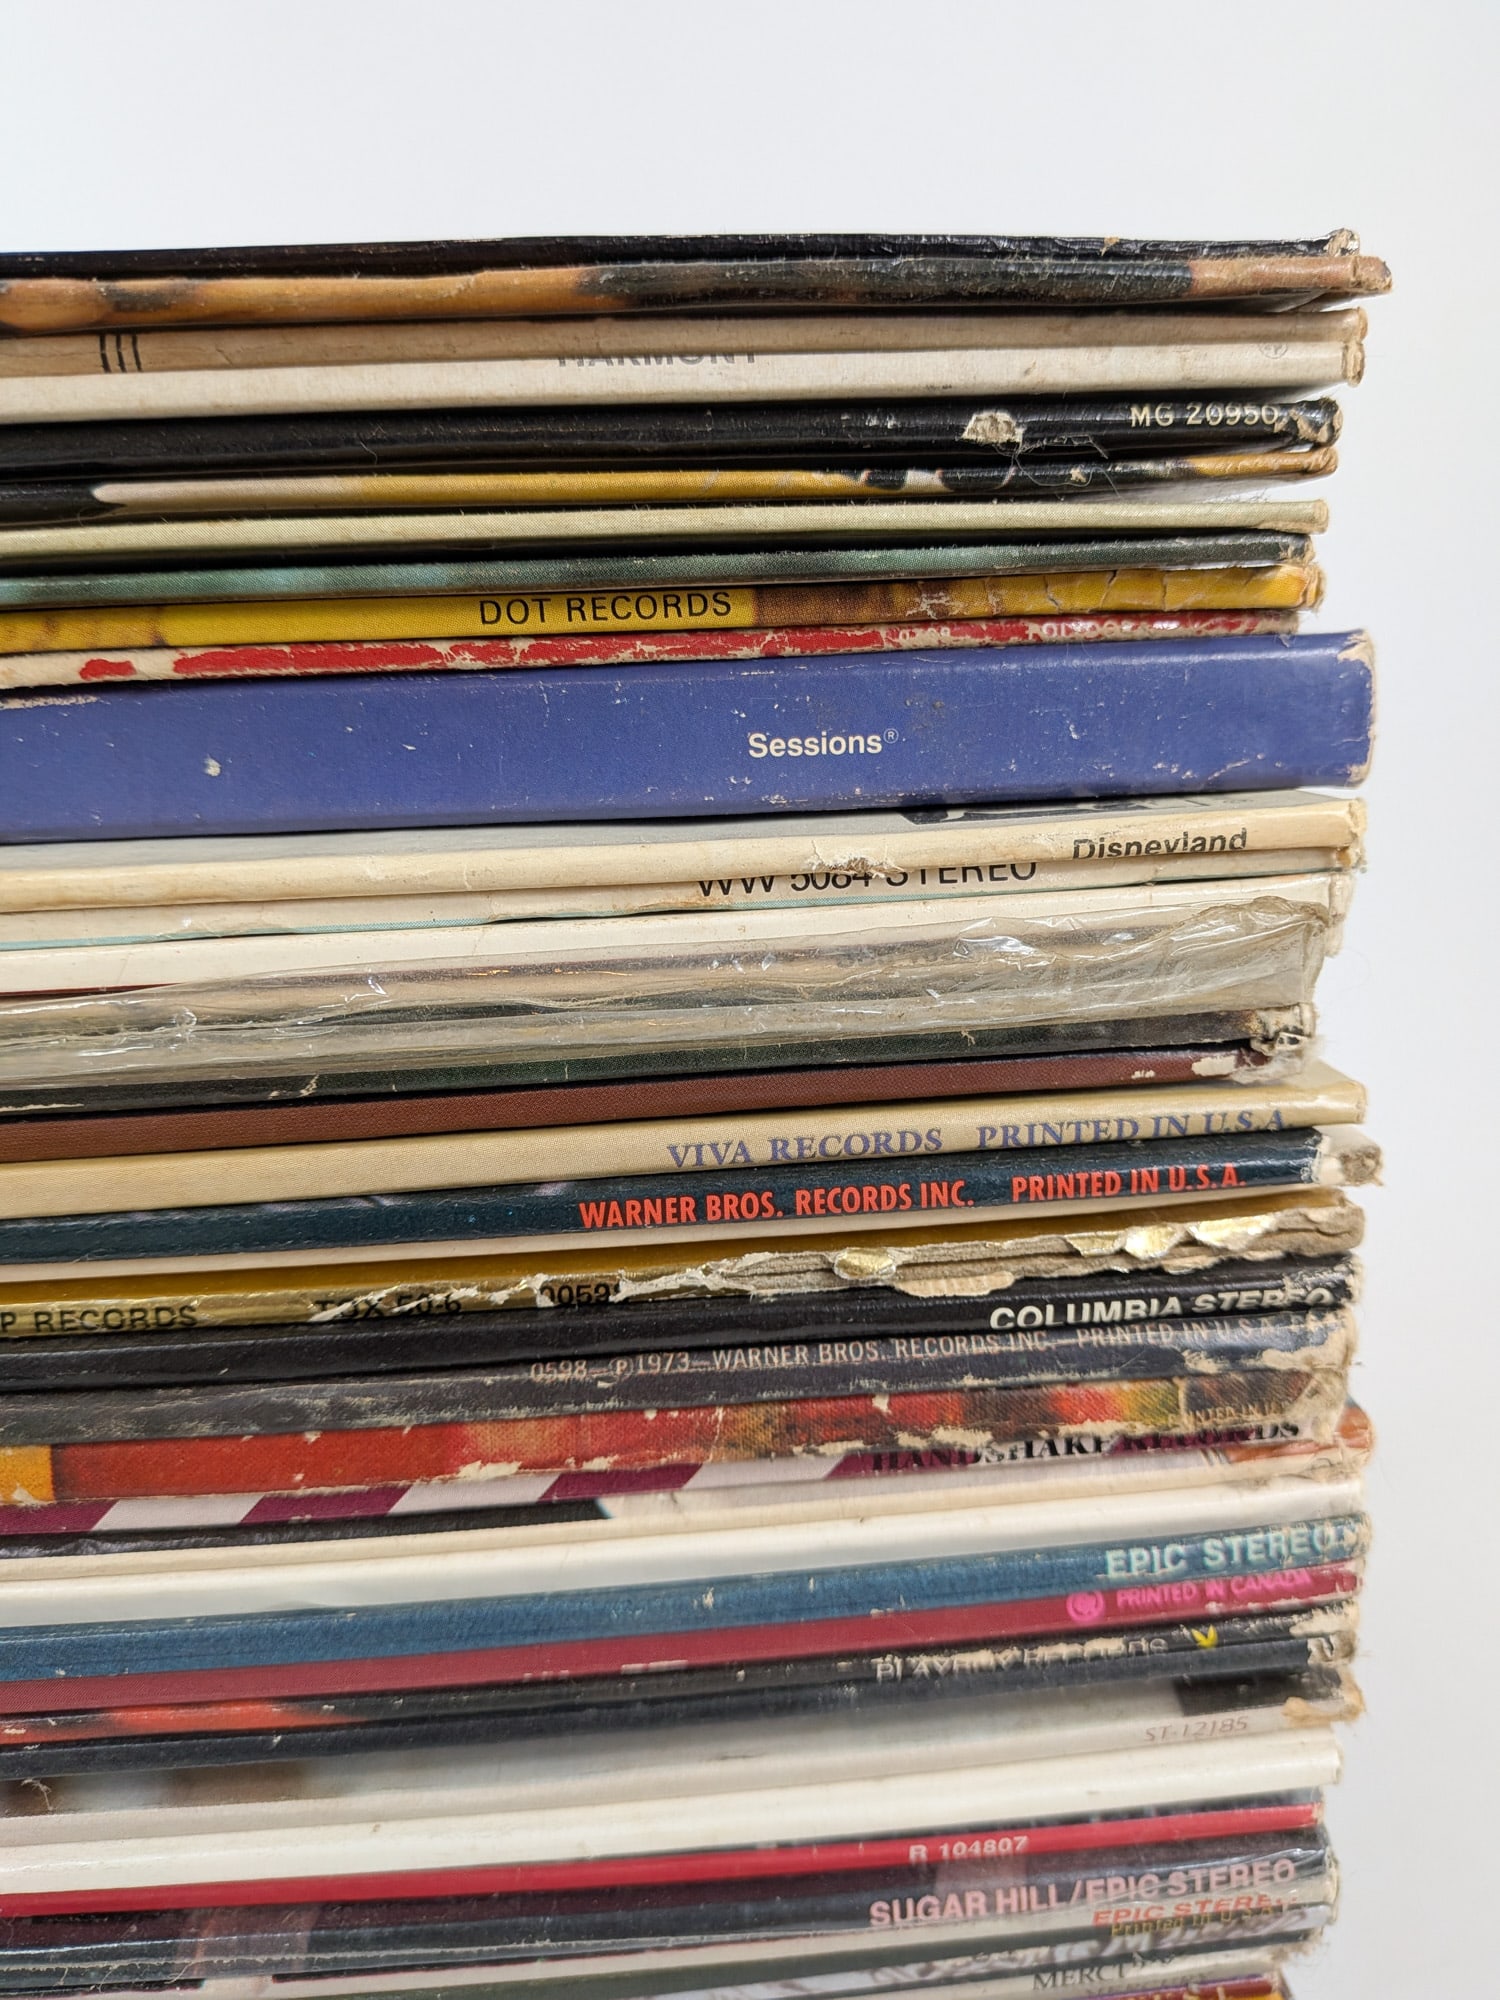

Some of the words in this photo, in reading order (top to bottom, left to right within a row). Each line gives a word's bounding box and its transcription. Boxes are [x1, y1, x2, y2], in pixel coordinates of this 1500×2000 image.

[1130, 402, 1175, 427] MG
[1186, 401, 1280, 426] 20950
[480, 598, 551, 625] DOT
[566, 591, 731, 622] RECORDS
[1072, 827, 1247, 859] Disneyland
[666, 1139, 754, 1168] VIVA
[768, 1127, 943, 1162] RECORDS
[976, 1117, 1139, 1148] PRINTED
[1152, 1114, 1190, 1138] IN
[579, 1196, 696, 1229] WARNER
[705, 1191, 783, 1222] BROS.
[795, 1183, 912, 1215] RECORDS
[919, 1180, 974, 1209] INC.
[1011, 1170, 1122, 1203] PRINTED
[1130, 1166, 1160, 1194] IN
[1168, 1162, 1247, 1192] U.S.A.
[33, 1304, 198, 1333] RECORDS
[989, 1296, 1183, 1330] COLUMBIA
[1192, 1286, 1335, 1314] STEREO
[819, 1341, 885, 1364] BROS.
[895, 1333, 999, 1360] RECORDS
[1106, 1545, 1187, 1579] EPIC
[1203, 1526, 1336, 1571] STEREO
[1116, 1581, 1198, 1608] PRINTED
[1204, 1577, 1226, 1598] IN
[1230, 1570, 1313, 1596] CANADA
[909, 1844, 928, 1862] R
[938, 1835, 1029, 1859] 104807
[869, 1889, 988, 1927] SUGAR
[1167, 1858, 1297, 1897] STEREO
[1092, 1905, 1164, 1927] EPIC
[1173, 1893, 1297, 1918] STERE
